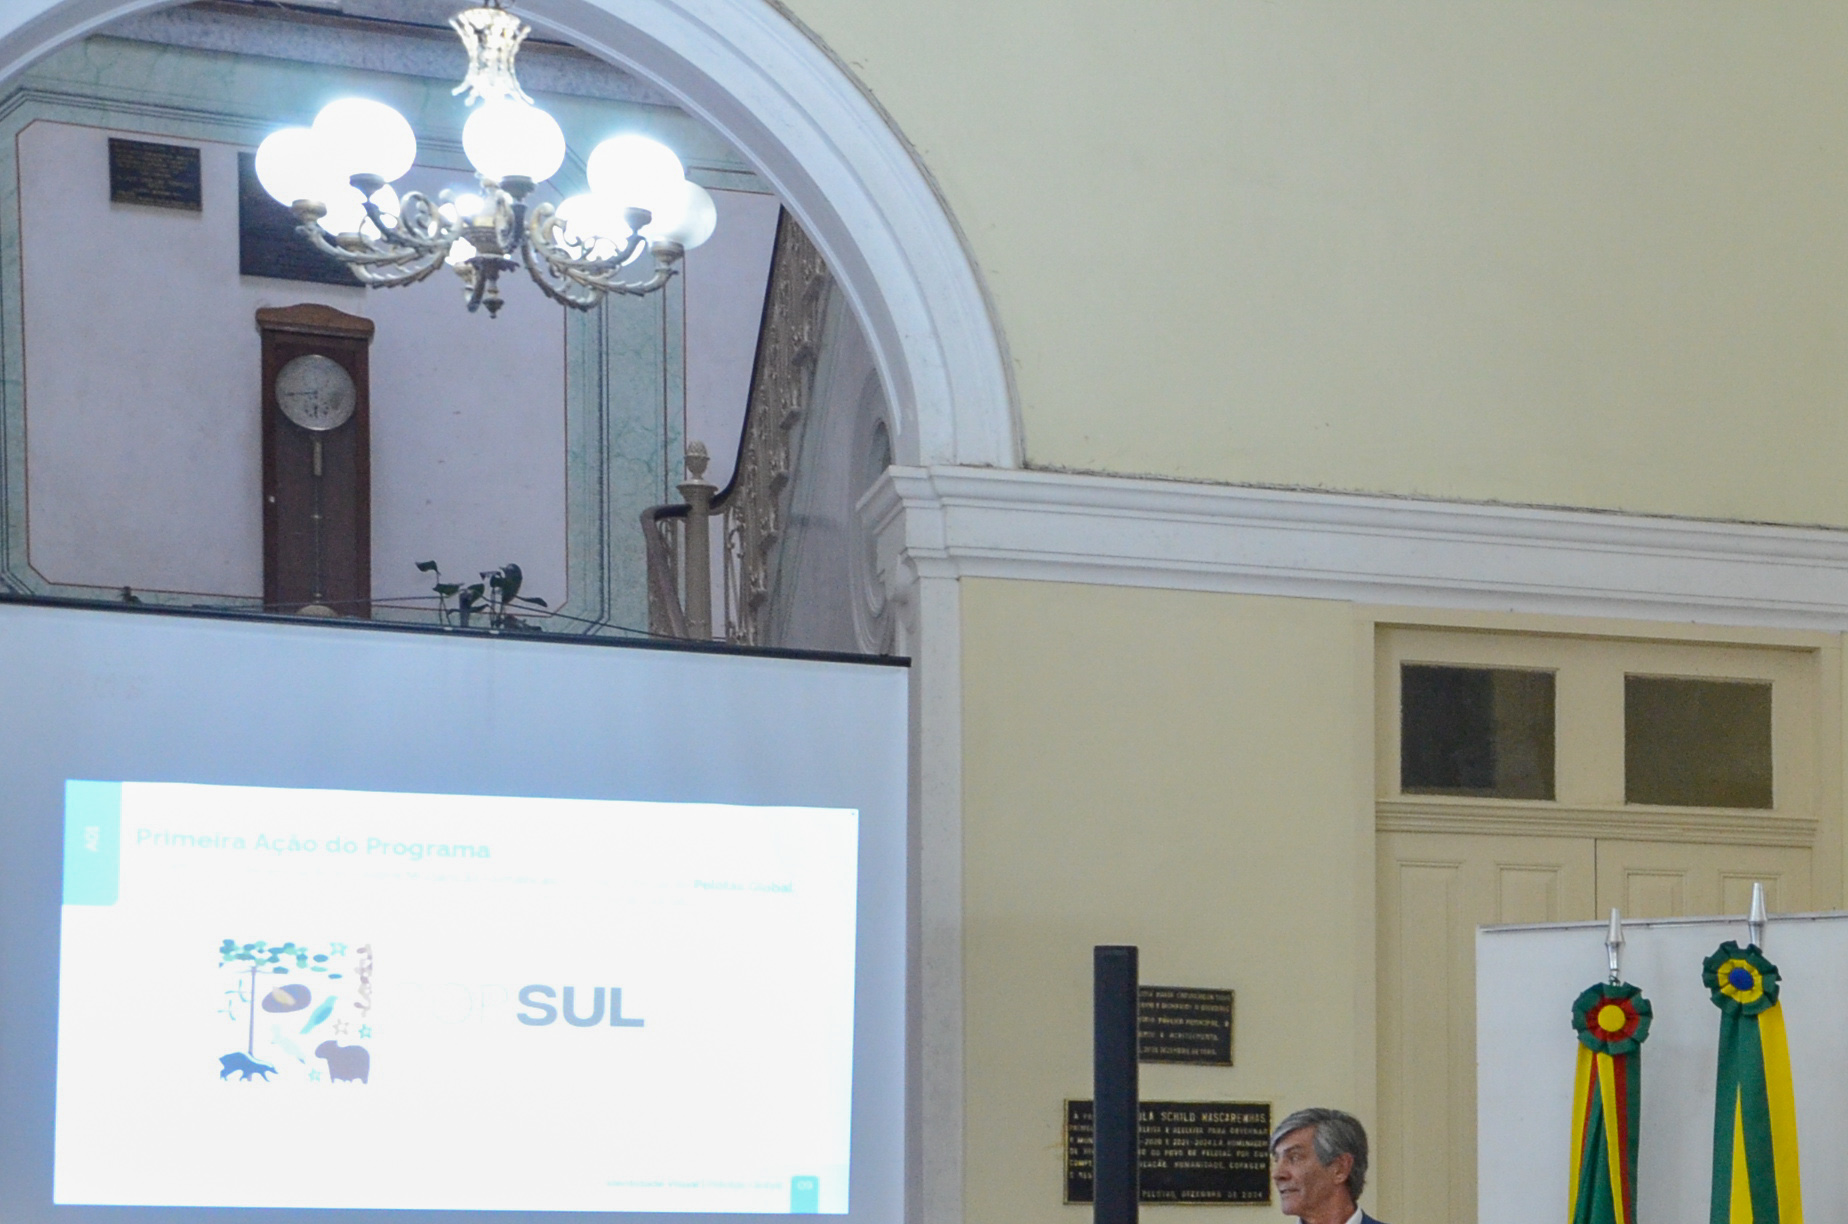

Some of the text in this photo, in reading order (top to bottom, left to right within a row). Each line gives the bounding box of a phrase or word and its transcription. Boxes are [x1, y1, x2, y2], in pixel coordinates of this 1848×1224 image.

[136, 827, 492, 863] Primeira Ação do Programa
[516, 983, 646, 1028] SUL
